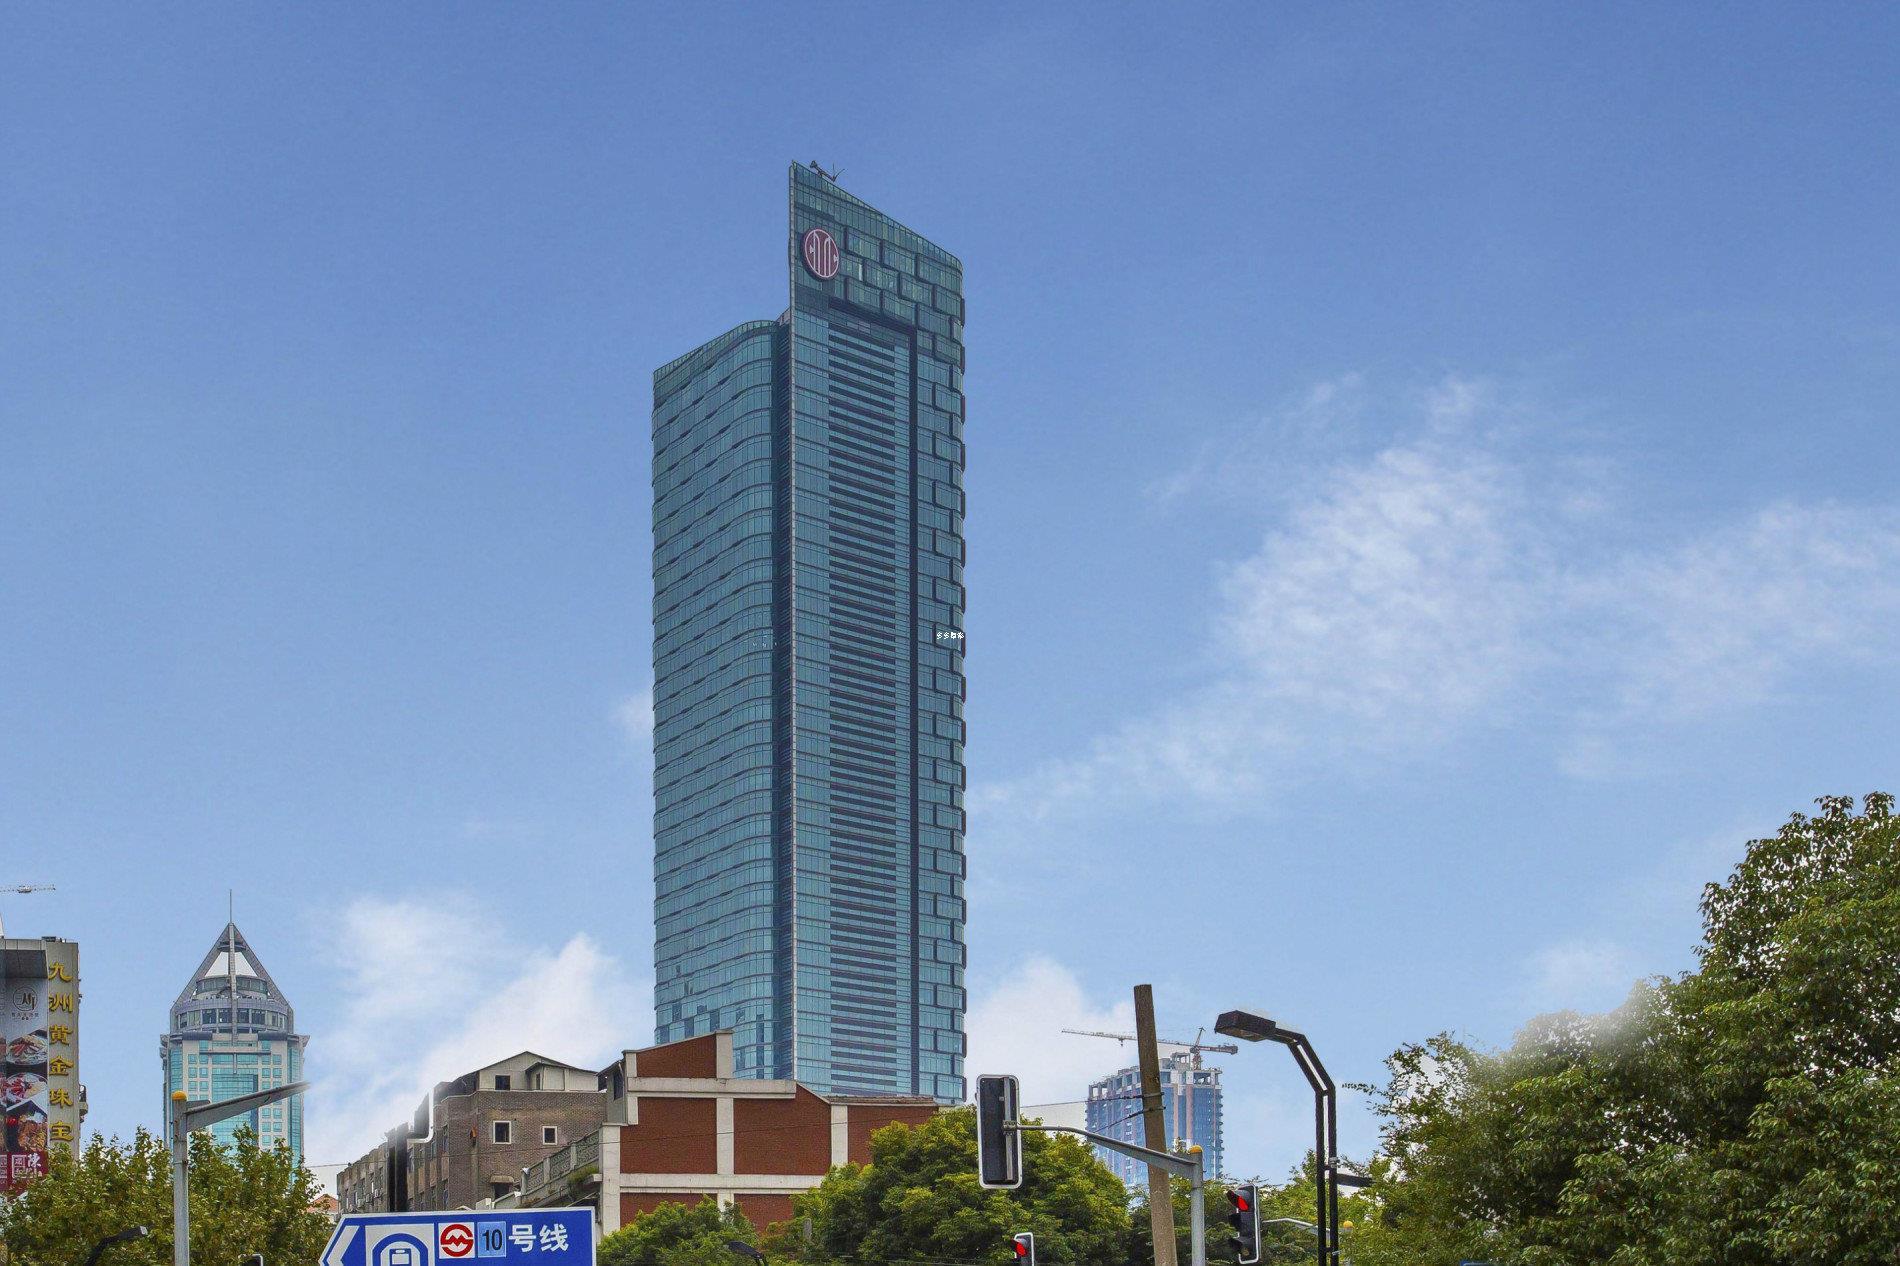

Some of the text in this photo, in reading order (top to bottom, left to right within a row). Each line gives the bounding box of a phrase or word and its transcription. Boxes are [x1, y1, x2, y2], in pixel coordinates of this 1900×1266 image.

[48, 962, 74, 1142] 九洲黄金珠宝
[482, 1223, 569, 1253] 10 号线
